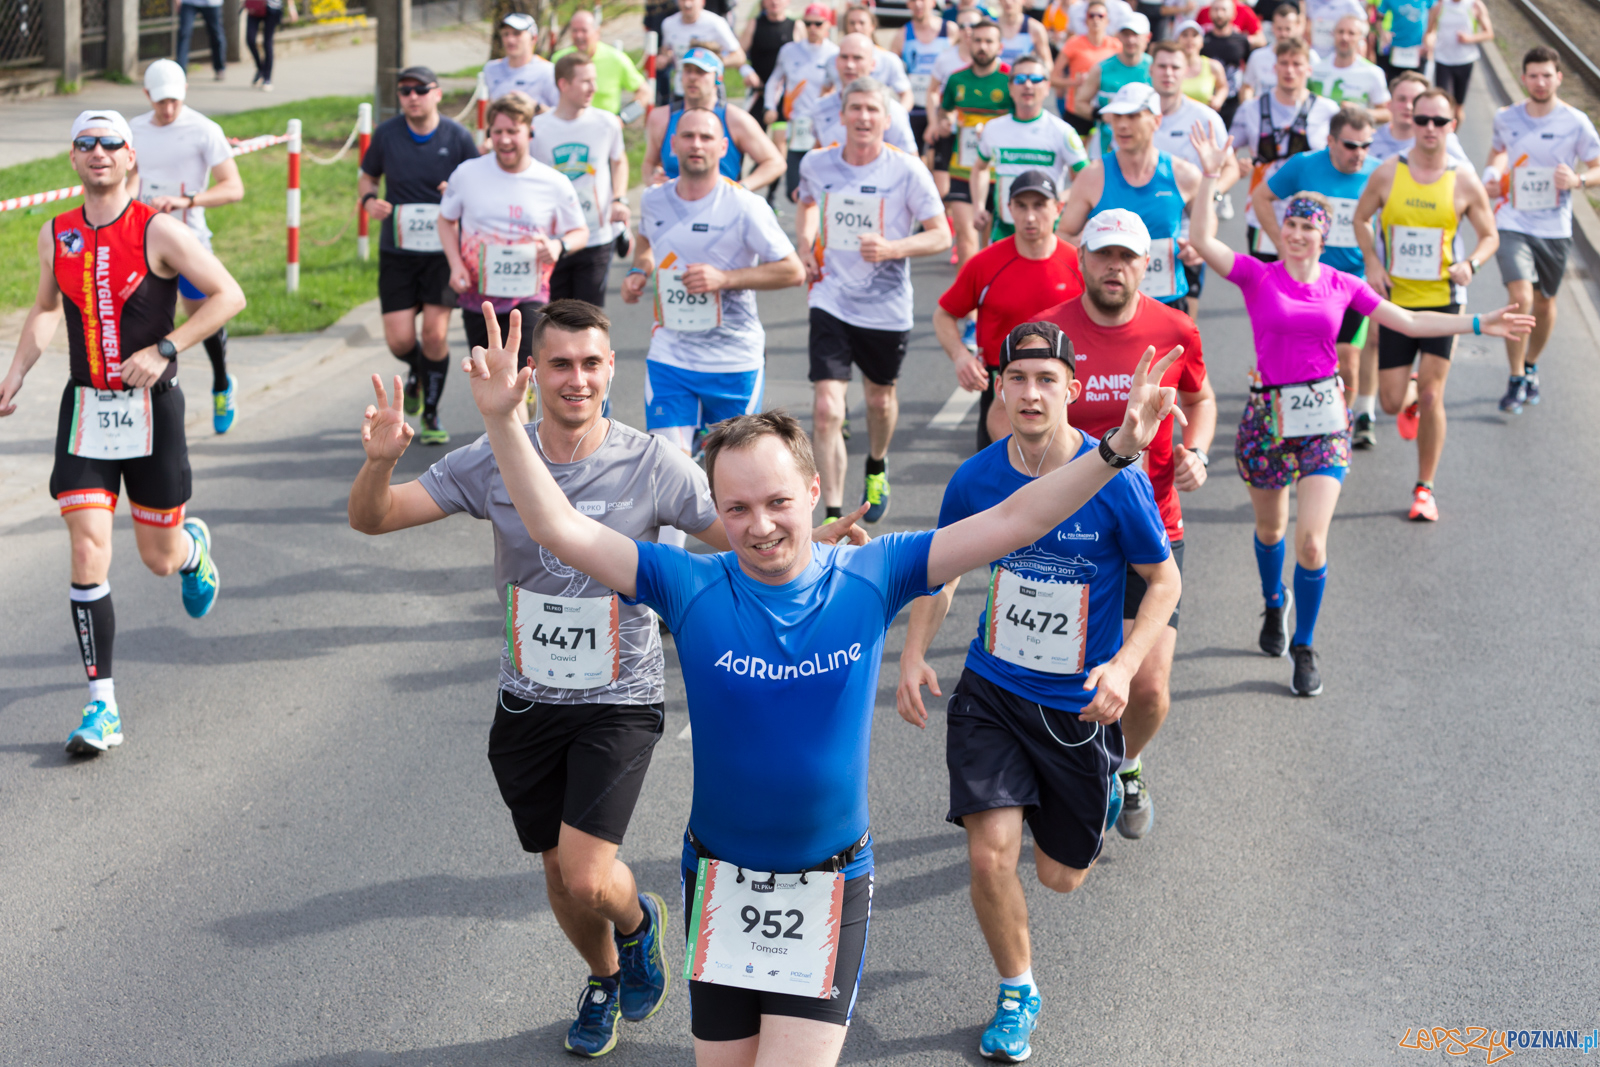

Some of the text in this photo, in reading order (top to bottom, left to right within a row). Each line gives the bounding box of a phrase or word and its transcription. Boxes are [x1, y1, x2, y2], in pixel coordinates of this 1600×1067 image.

[1522, 181, 1550, 192] 4127
[409, 219, 438, 231] 224
[835, 211, 872, 228] 9014
[1400, 243, 1433, 257] 6813
[493, 261, 530, 275] 2823
[1086, 392, 1109, 401] Run
[1290, 389, 1334, 410] 2493
[1058, 567, 1075, 575] 2017
[1006, 604, 1068, 635] 4472
[532, 623, 596, 650] 4471
[1026, 635, 1041, 645] Filip
[550, 653, 577, 662] Dawid
[714, 642, 862, 680] AdRunaLine
[741, 905, 804, 940] 952
[751, 941, 788, 955] Tomasz
